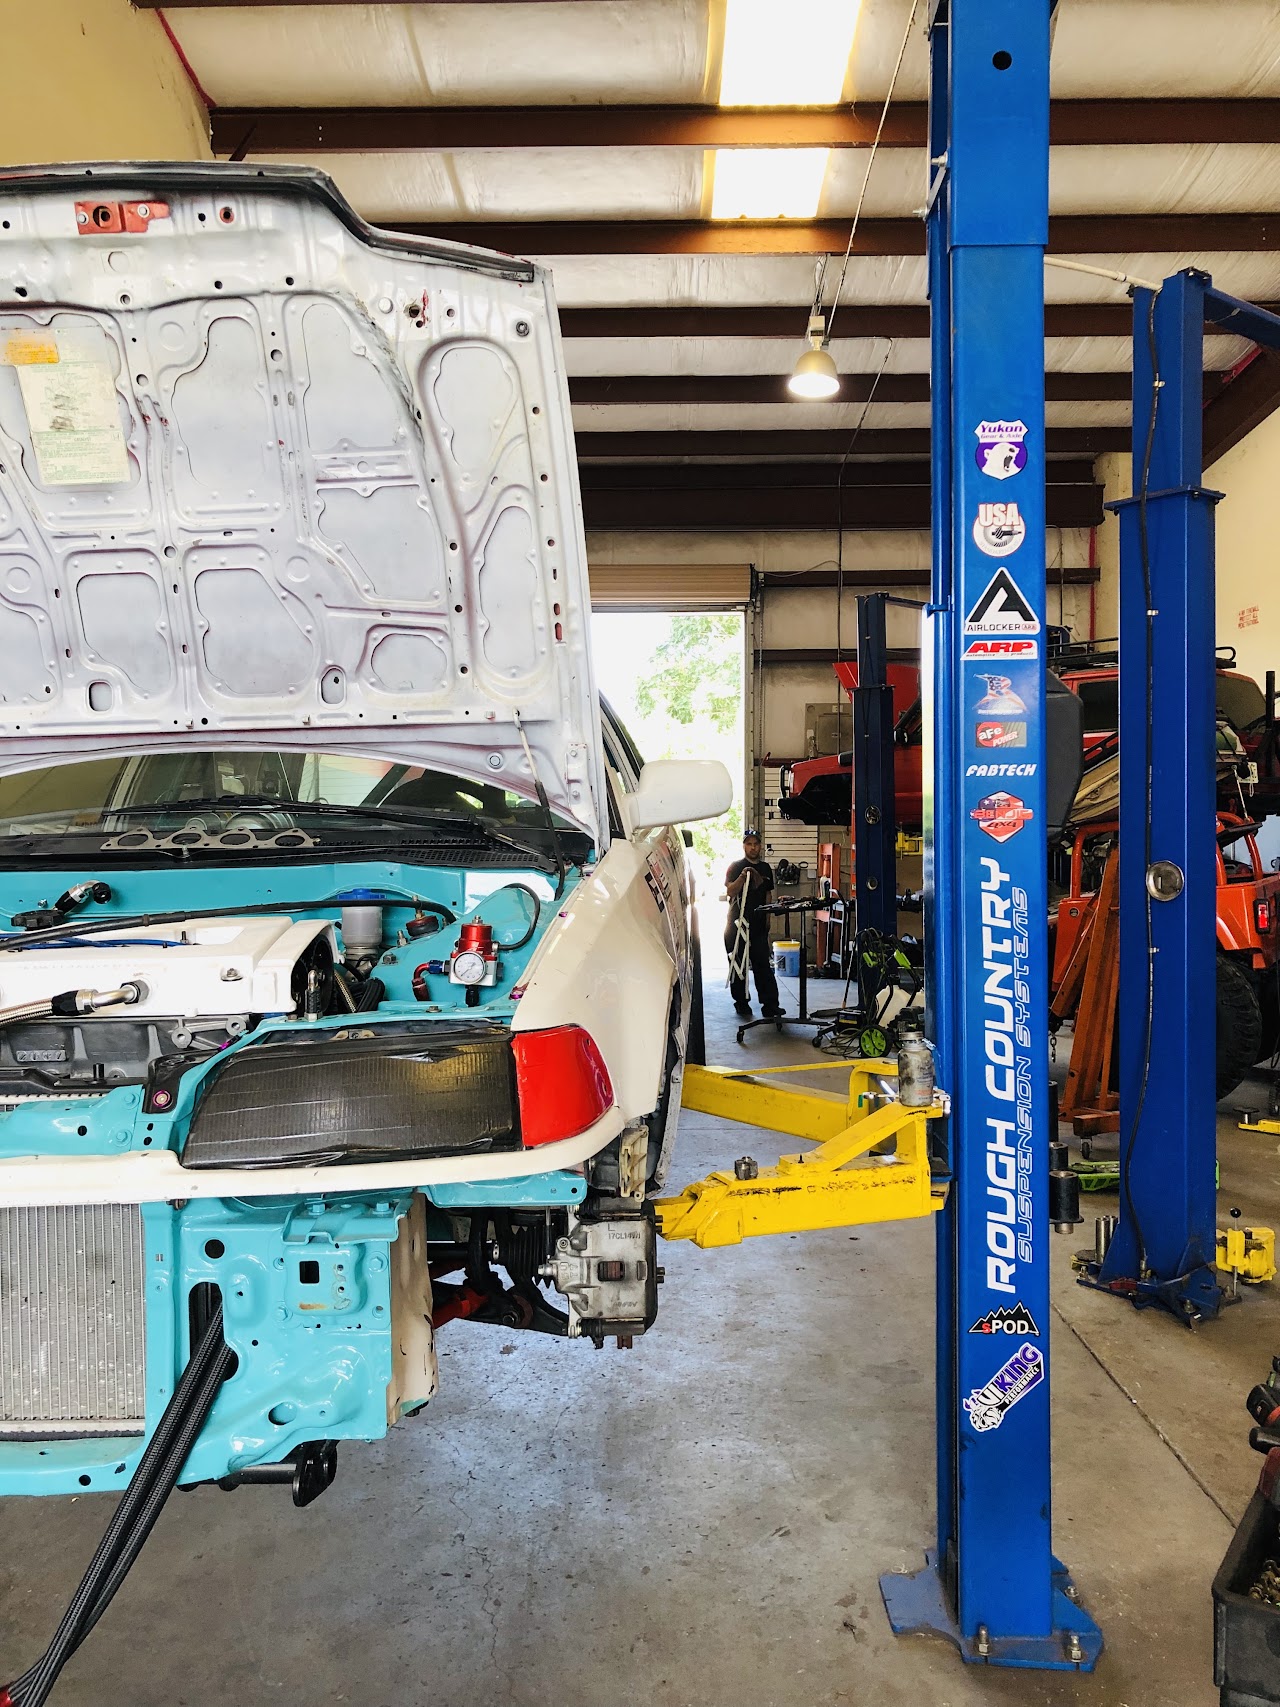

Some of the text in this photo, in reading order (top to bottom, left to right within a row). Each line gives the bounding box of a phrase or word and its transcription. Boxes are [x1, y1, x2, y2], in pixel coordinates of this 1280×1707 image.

[981, 424, 1023, 433] Yukon
[978, 502, 1021, 527] USA
[966, 623, 1021, 632] AIRLOCKER
[967, 641, 1033, 653] ARP
[992, 731, 1019, 747] POWER
[965, 763, 1038, 777] FABTECH
[980, 856, 1016, 1294] ROUGH COUNTRY
[1011, 886, 1033, 1264] SUSPENSION SYSTEMS
[981, 1319, 1029, 1335] sPOD
[977, 1346, 1040, 1406] VIKING
[1004, 1365, 1040, 1405] PERFORMANCE
